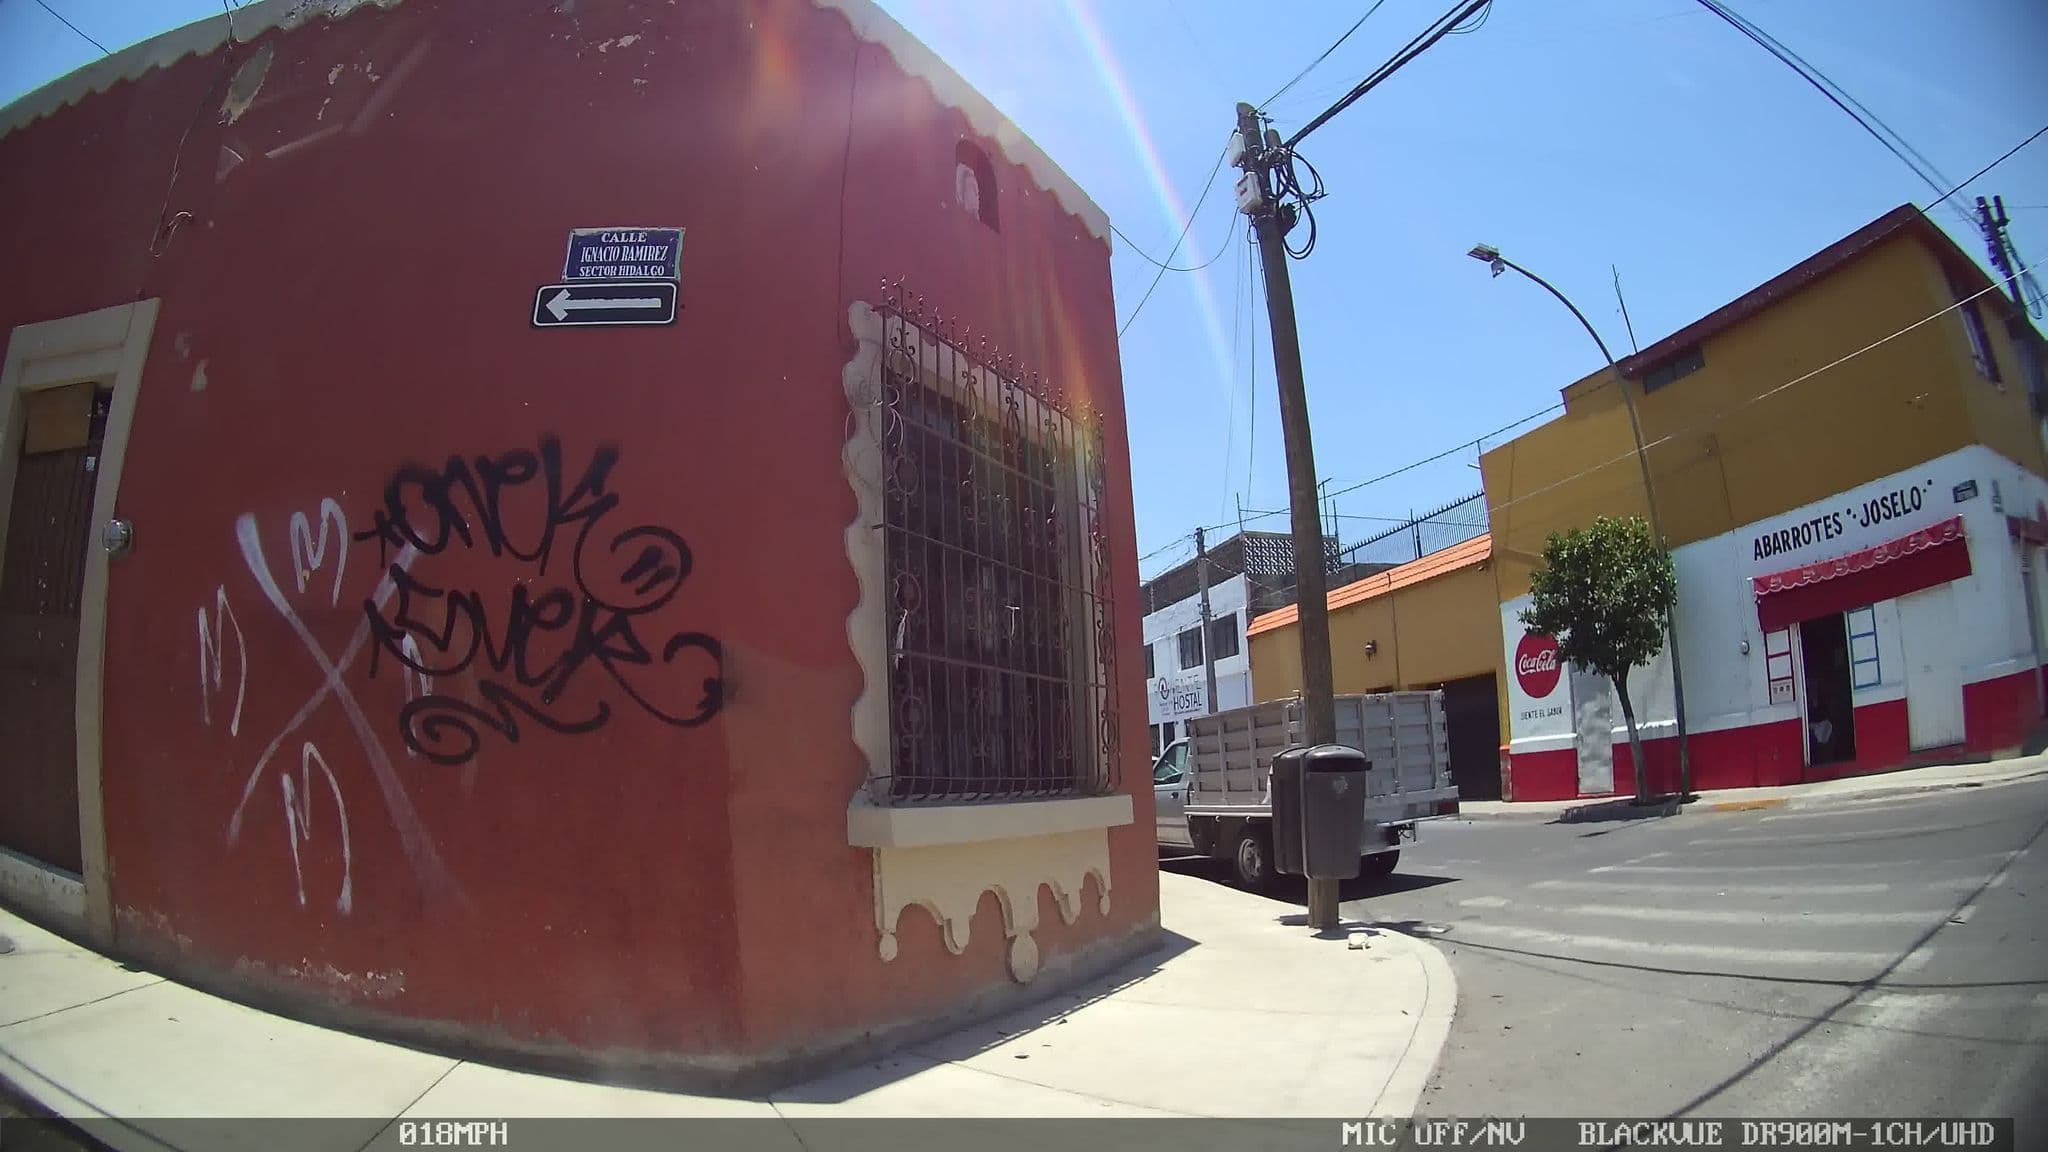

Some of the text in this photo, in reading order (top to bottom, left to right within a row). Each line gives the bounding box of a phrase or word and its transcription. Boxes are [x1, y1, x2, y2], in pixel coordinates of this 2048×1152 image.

[601, 232, 648, 243] CALLE
[580, 245, 669, 263] IGNACIO RAMIREZ
[579, 265, 665, 277] SECTOR HIDALGO
[1753, 511, 1844, 561] ABARROTES
[1173, 691, 1203, 711] HOSTAL
